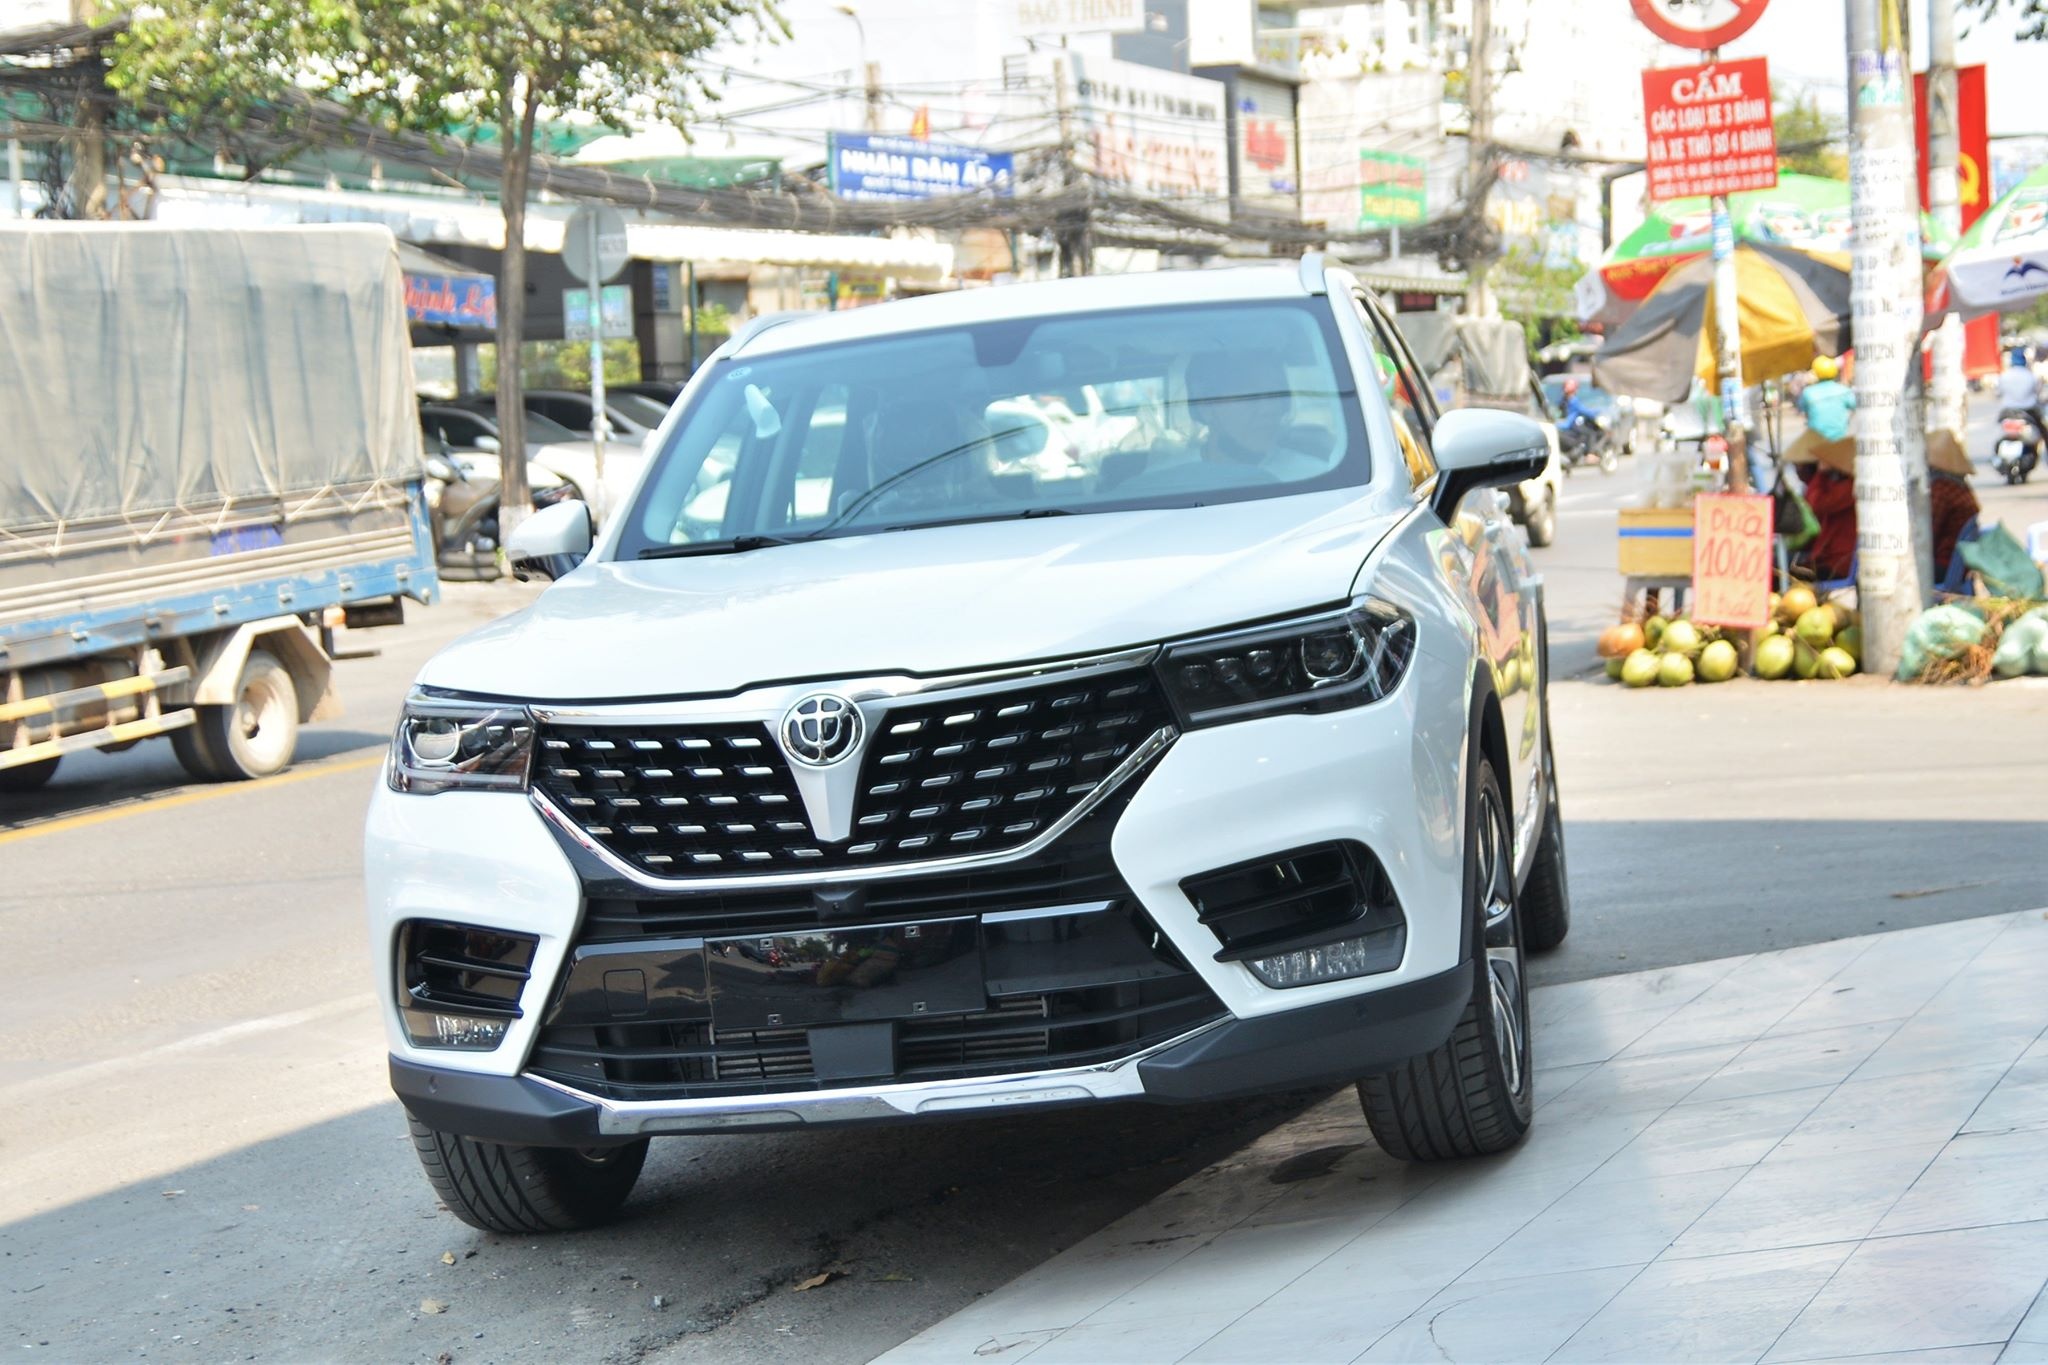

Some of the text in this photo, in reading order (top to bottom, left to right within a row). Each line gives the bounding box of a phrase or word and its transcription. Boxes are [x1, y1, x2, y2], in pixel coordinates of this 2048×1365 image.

[1673, 66, 1742, 103] CẤM
[1652, 106, 1676, 133] CÁC
[1707, 104, 1722, 128] XE
